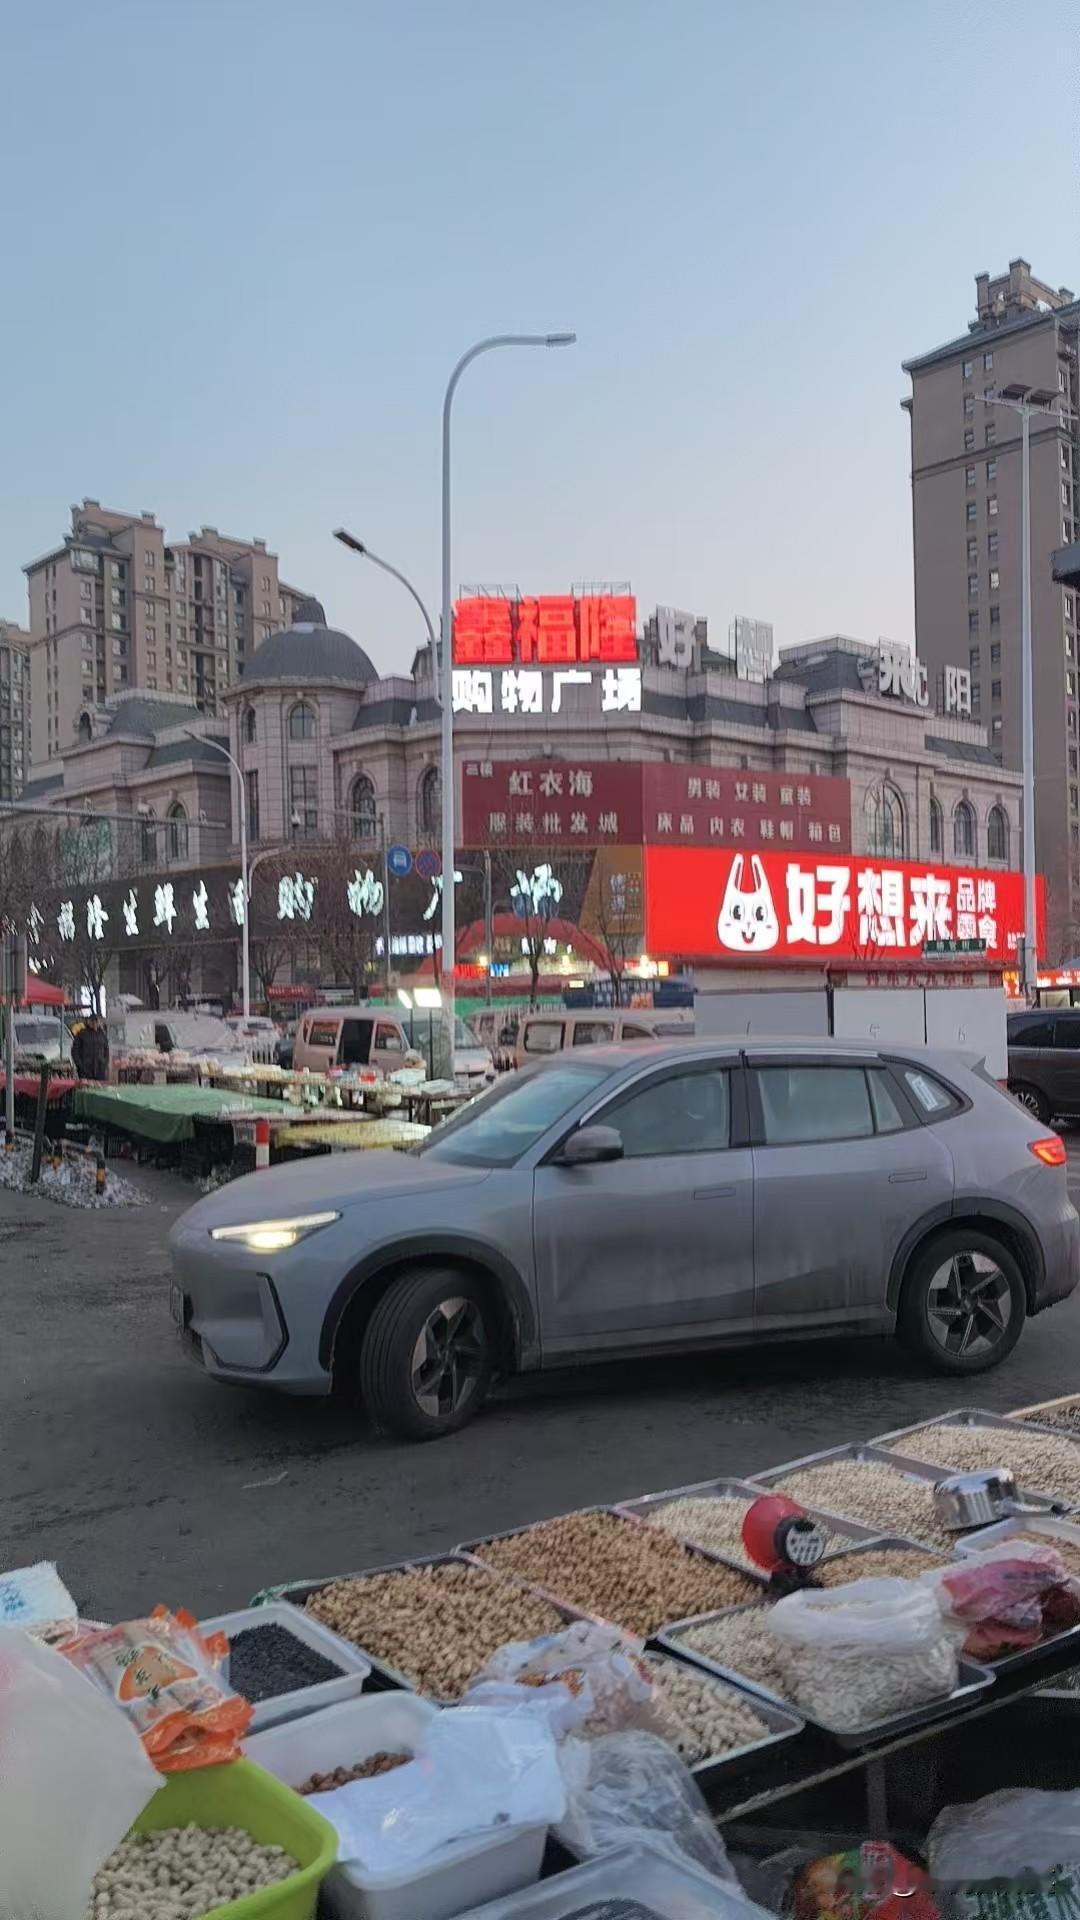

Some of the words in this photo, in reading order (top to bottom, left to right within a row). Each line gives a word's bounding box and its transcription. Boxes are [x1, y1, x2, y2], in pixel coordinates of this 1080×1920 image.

[452, 668, 641, 713] 购物广场
[688, 777, 720, 799] 男装
[736, 782, 767, 803] 女装
[780, 786, 811, 806] 童装
[489, 811, 618, 833] 服装批发城
[658, 812, 694, 834] 床品
[710, 817, 744, 837] 内衣
[760, 819, 794, 840] 鞋帽
[808, 822, 841, 842] 箱包
[785, 862, 952, 947] 好想来
[956, 877, 996, 912] 品牌
